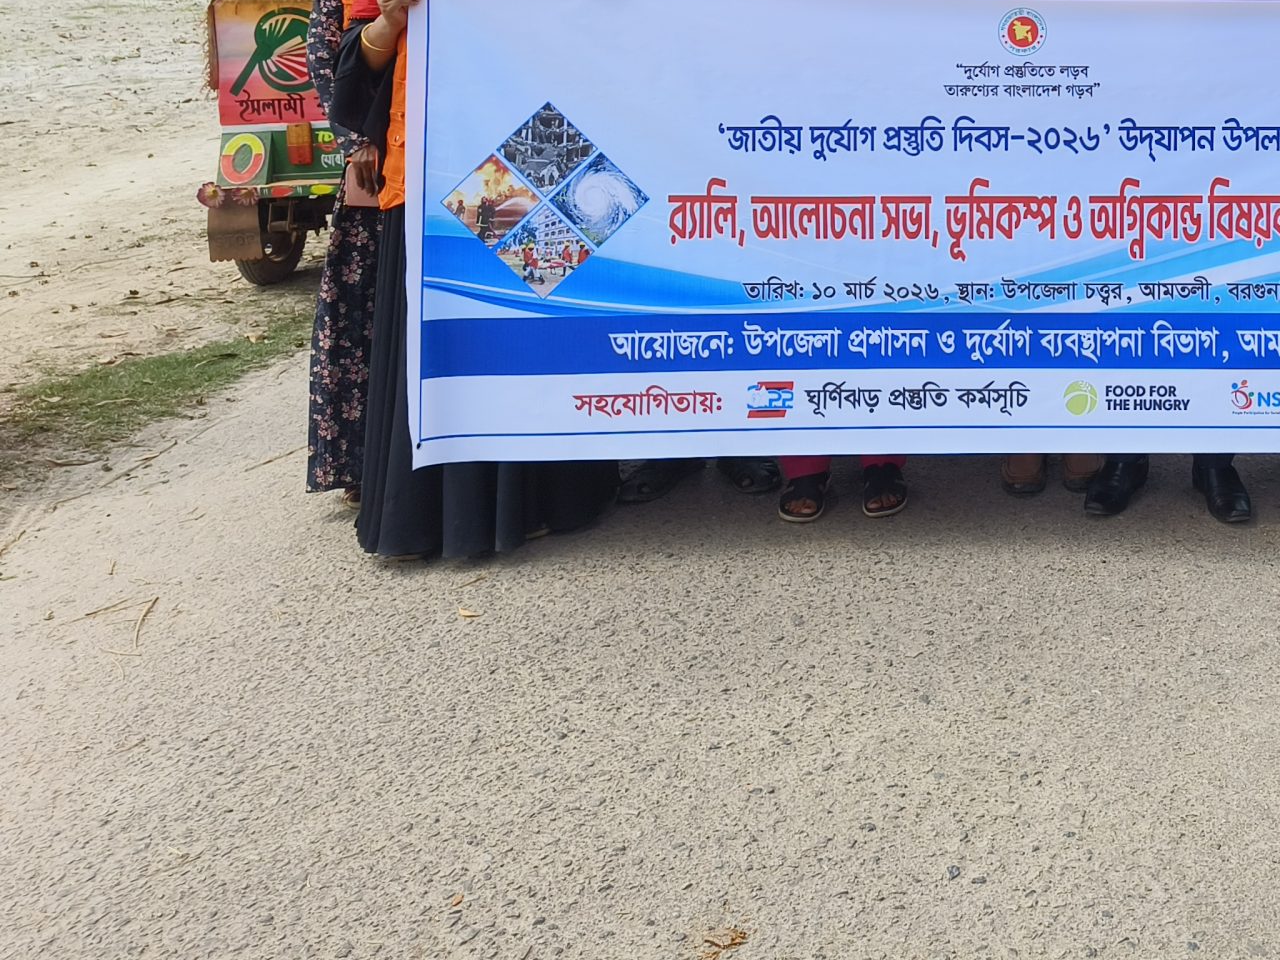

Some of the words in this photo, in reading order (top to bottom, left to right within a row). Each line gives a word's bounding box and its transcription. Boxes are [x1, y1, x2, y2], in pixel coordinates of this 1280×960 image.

[1003, 61, 1056, 79] প্রস্তুতিতে
[1059, 65, 1090, 80] লড়ব
[943, 84, 999, 97] তারুণ্যের
[1003, 84, 1062, 98] বাংলাদেশ
[1065, 82, 1101, 99] গড়ব”
[234, 90, 305, 122] ইসলামী
[809, 118, 877, 162] দুর্যোগ
[883, 115, 946, 157] প্রস্তুতি
[750, 195, 876, 241] আলোচনা
[880, 195, 939, 249] সভা,
[945, 177, 1058, 262] ভূমিকম্প
[1063, 195, 1083, 240] ও
[1089, 177, 1204, 261] অগ্নিকান্ড
[811, 282, 836, 301] ১০
[844, 276, 878, 300] মার্চ
[1001, 276, 1076, 300] উপজেলা
[742, 321, 842, 358] উপজেলা
[848, 326, 930, 359] প্রশাসন
[936, 330, 956, 356] ও
[962, 319, 1034, 364] দুর্যোগ
[1038, 325, 1144, 363] ব্যবস্থাপনা
[1151, 319, 1230, 363] বিভাগ,
[804, 381, 882, 418] ঘূর্ণিঝড়
[888, 381, 950, 411] প্রস্তুতি
[955, 380, 1031, 416] কর্মসূচি
[1105, 385, 1146, 397] FOOD
[1149, 385, 1177, 397] FOR
[1105, 399, 1130, 411] THE
[1133, 399, 1191, 411] HUNGRY
